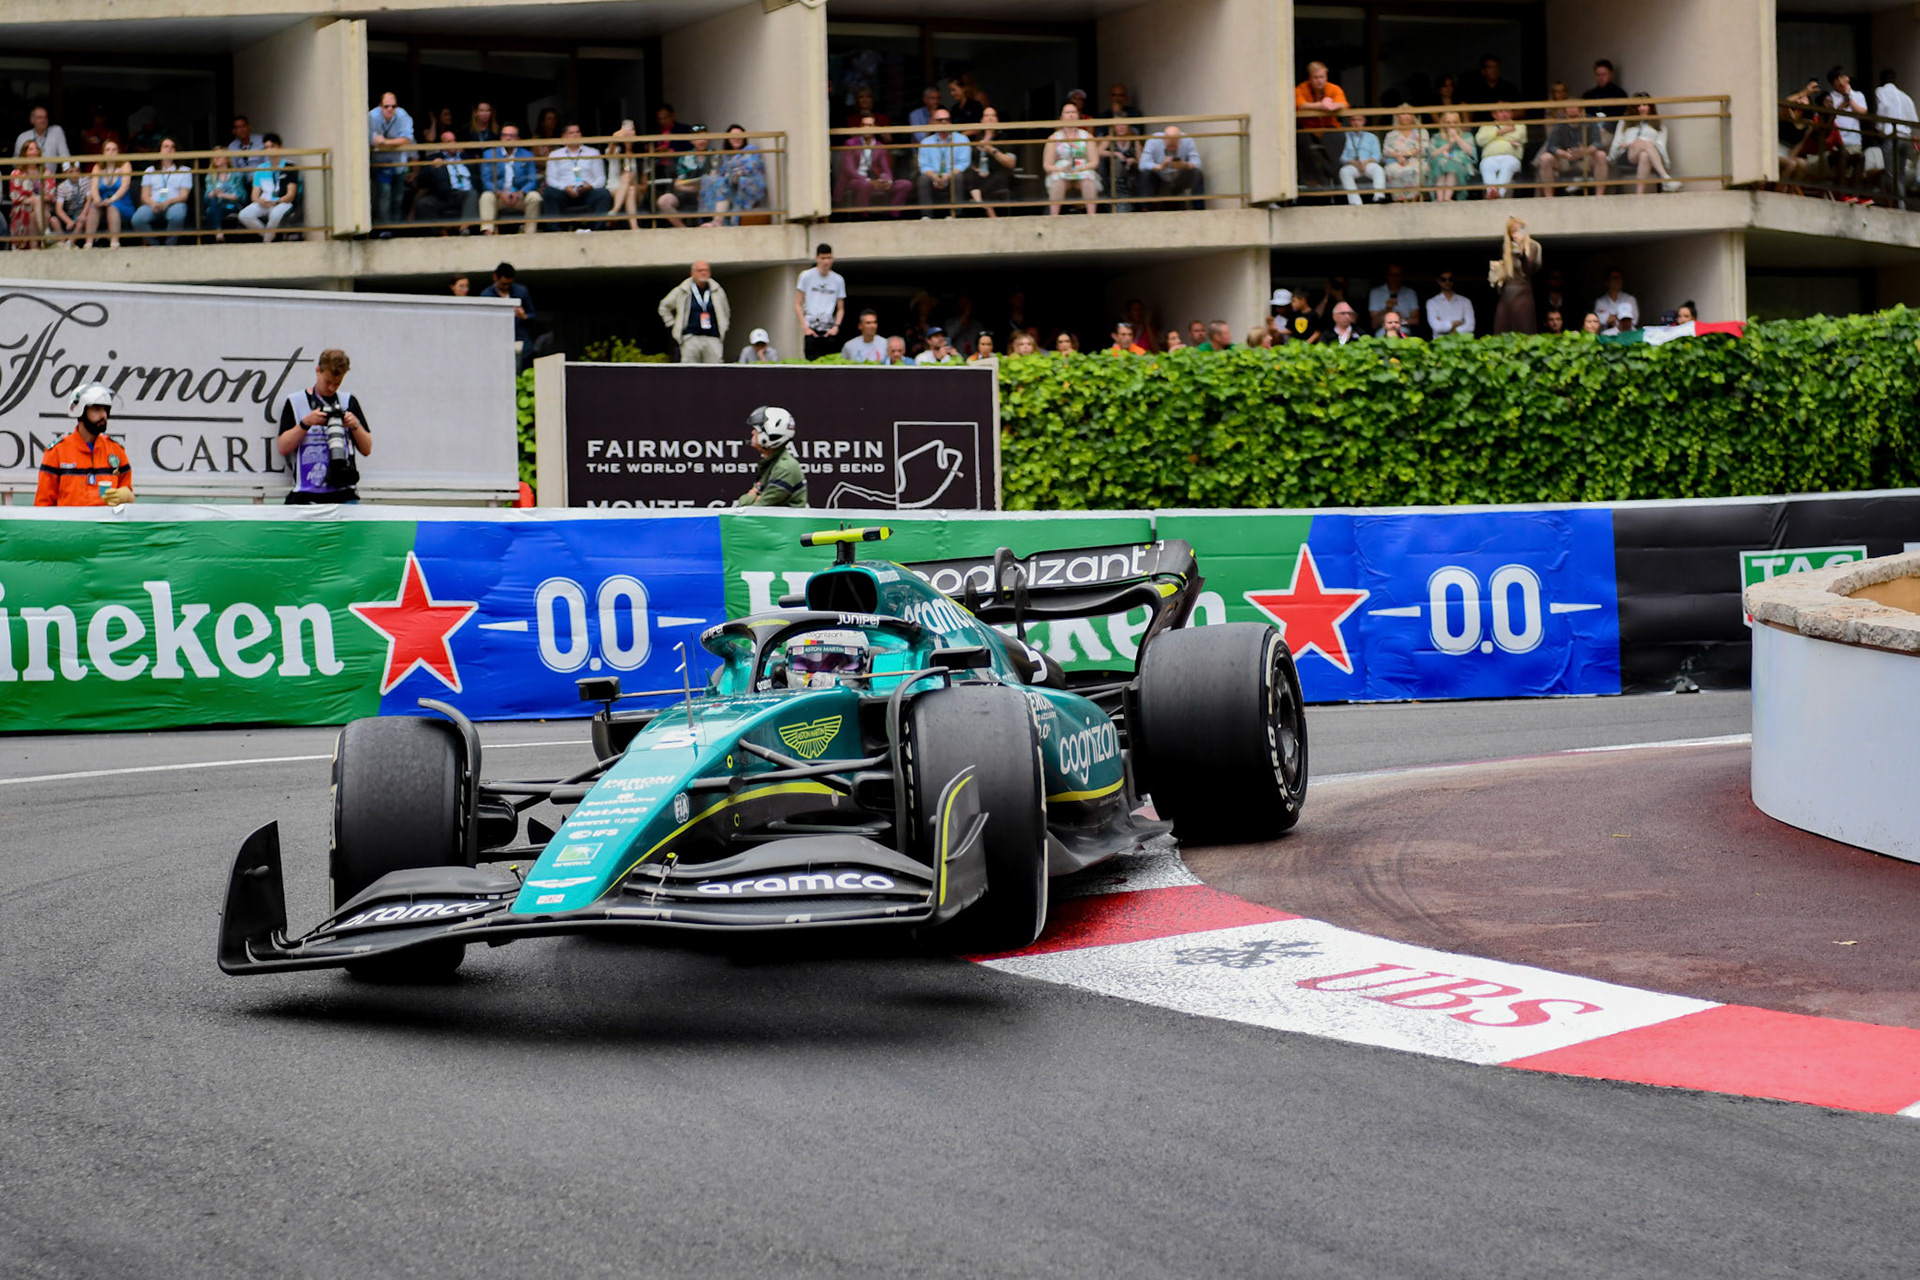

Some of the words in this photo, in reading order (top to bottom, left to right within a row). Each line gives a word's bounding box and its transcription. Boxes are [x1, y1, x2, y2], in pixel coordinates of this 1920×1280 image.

[151, 434, 297, 473] CARL
[586, 463, 621, 474] THE
[627, 462, 705, 474] WORLD'S
[711, 463, 759, 474] MOST
[840, 463, 886, 474] BEND
[587, 440, 744, 459] FAIRMONT
[762, 441, 884, 459] AIRPIN
[911, 545, 1147, 610] ogizant
[535, 575, 653, 673] 0.0
[1427, 563, 1546, 656] 0.0
[1060, 717, 1121, 785] cognizan
[697, 873, 895, 894] aramco
[335, 903, 489, 929] aramco
[1296, 963, 1604, 1028] UBS
